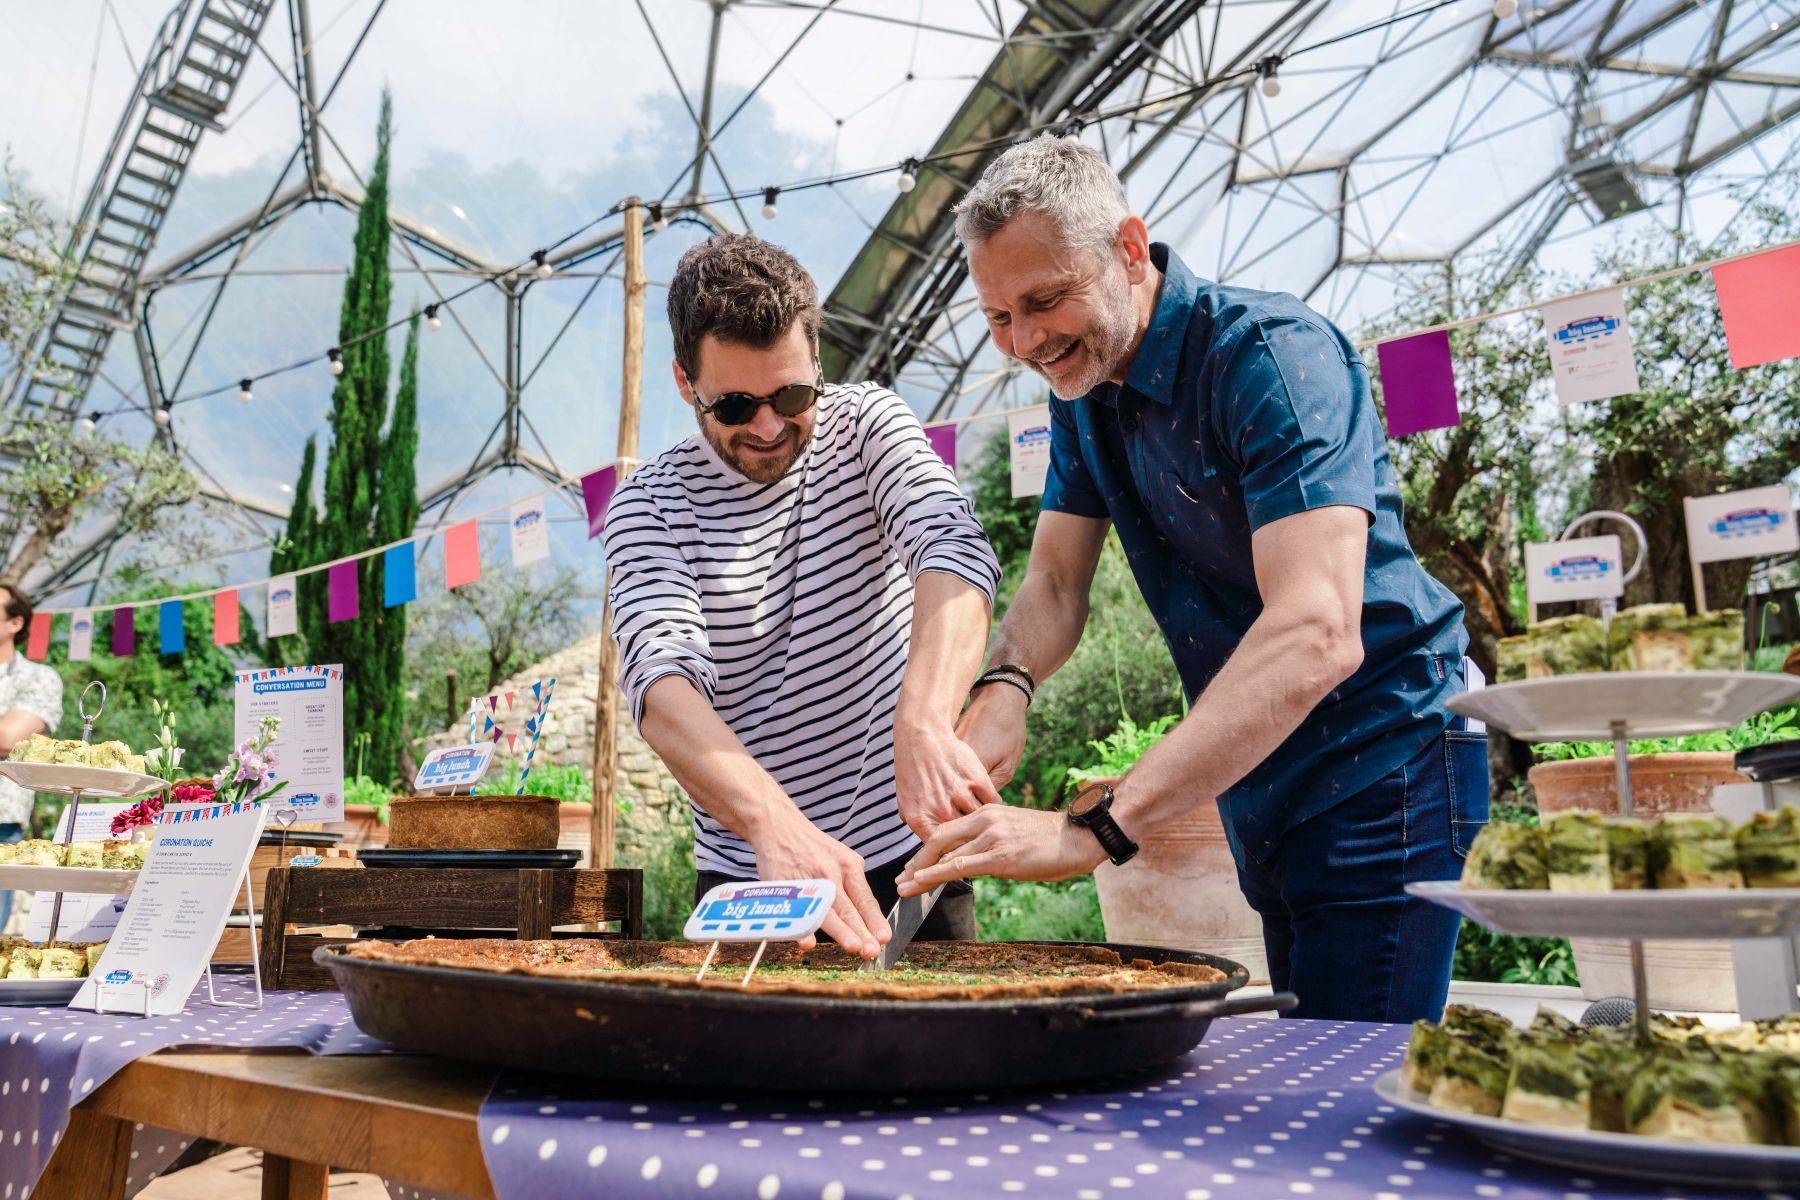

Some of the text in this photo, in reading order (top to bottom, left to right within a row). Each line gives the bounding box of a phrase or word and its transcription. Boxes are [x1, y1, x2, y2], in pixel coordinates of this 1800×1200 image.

[256, 681, 325, 691] CONVERSATION MENU
[433, 759, 470, 775] big lunch
[160, 838, 214, 847] CORONATION QUICHE
[743, 887, 792, 897] CORONATION
[722, 900, 792, 919] big lunch
